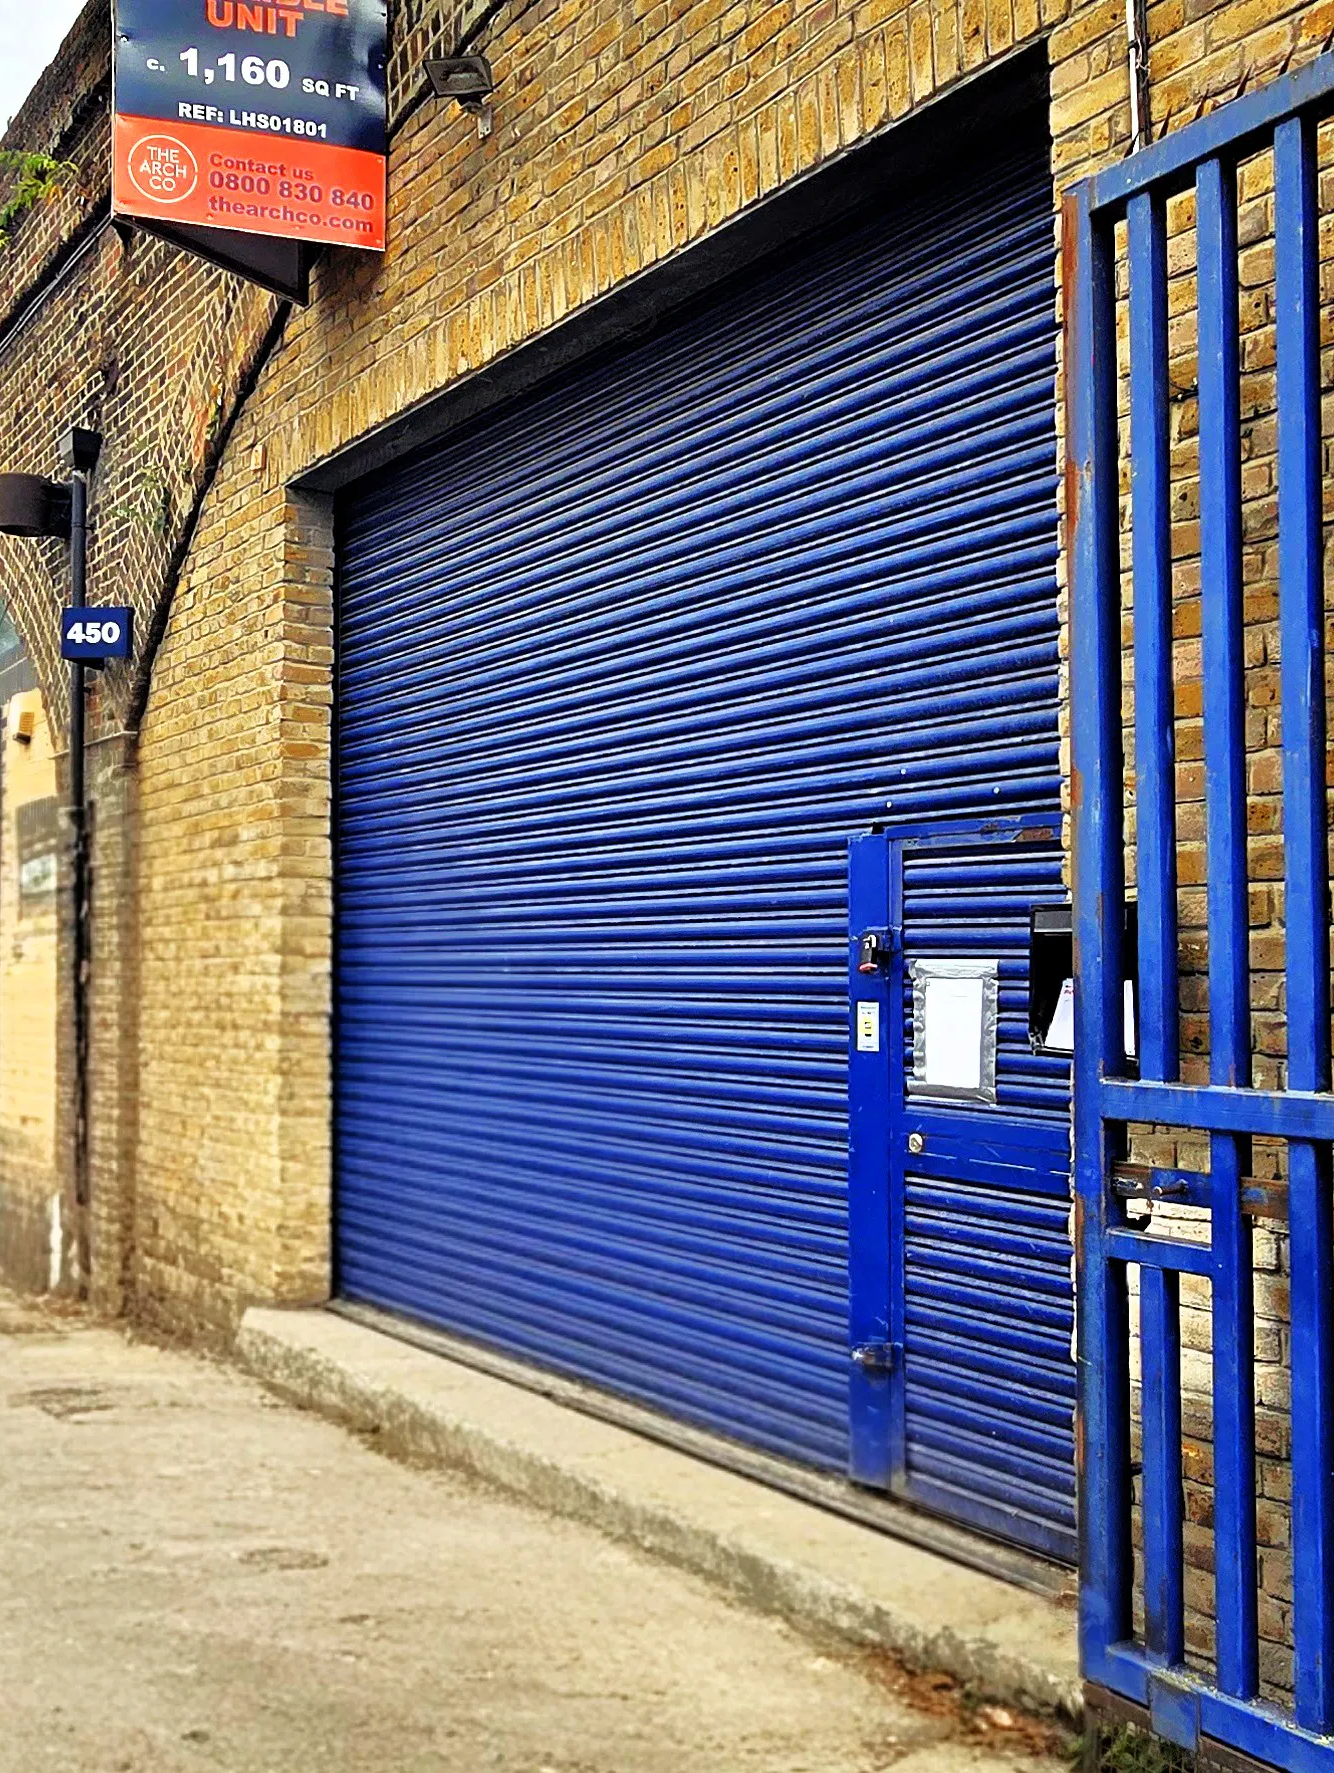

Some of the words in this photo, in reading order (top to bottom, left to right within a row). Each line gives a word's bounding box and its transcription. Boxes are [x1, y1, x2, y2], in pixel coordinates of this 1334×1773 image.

[207, 1, 304, 37] UNIT
[179, 47, 290, 89] 1,160
[302, 78, 330, 98] SQ
[335, 84, 359, 101] FT
[178, 102, 224, 123] REF:
[229, 110, 327, 138] LHS01801
[139, 159, 187, 179] ARCH
[147, 145, 180, 164] THE
[209, 153, 286, 177] Contact
[292, 167, 314, 181] us
[149, 175, 176, 192] CO
[209, 171, 270, 195] 0800
[279, 180, 323, 204] 830
[331, 188, 375, 211] 840
[209, 195, 373, 233] thearchco.com
[66, 621, 121, 644] 450
